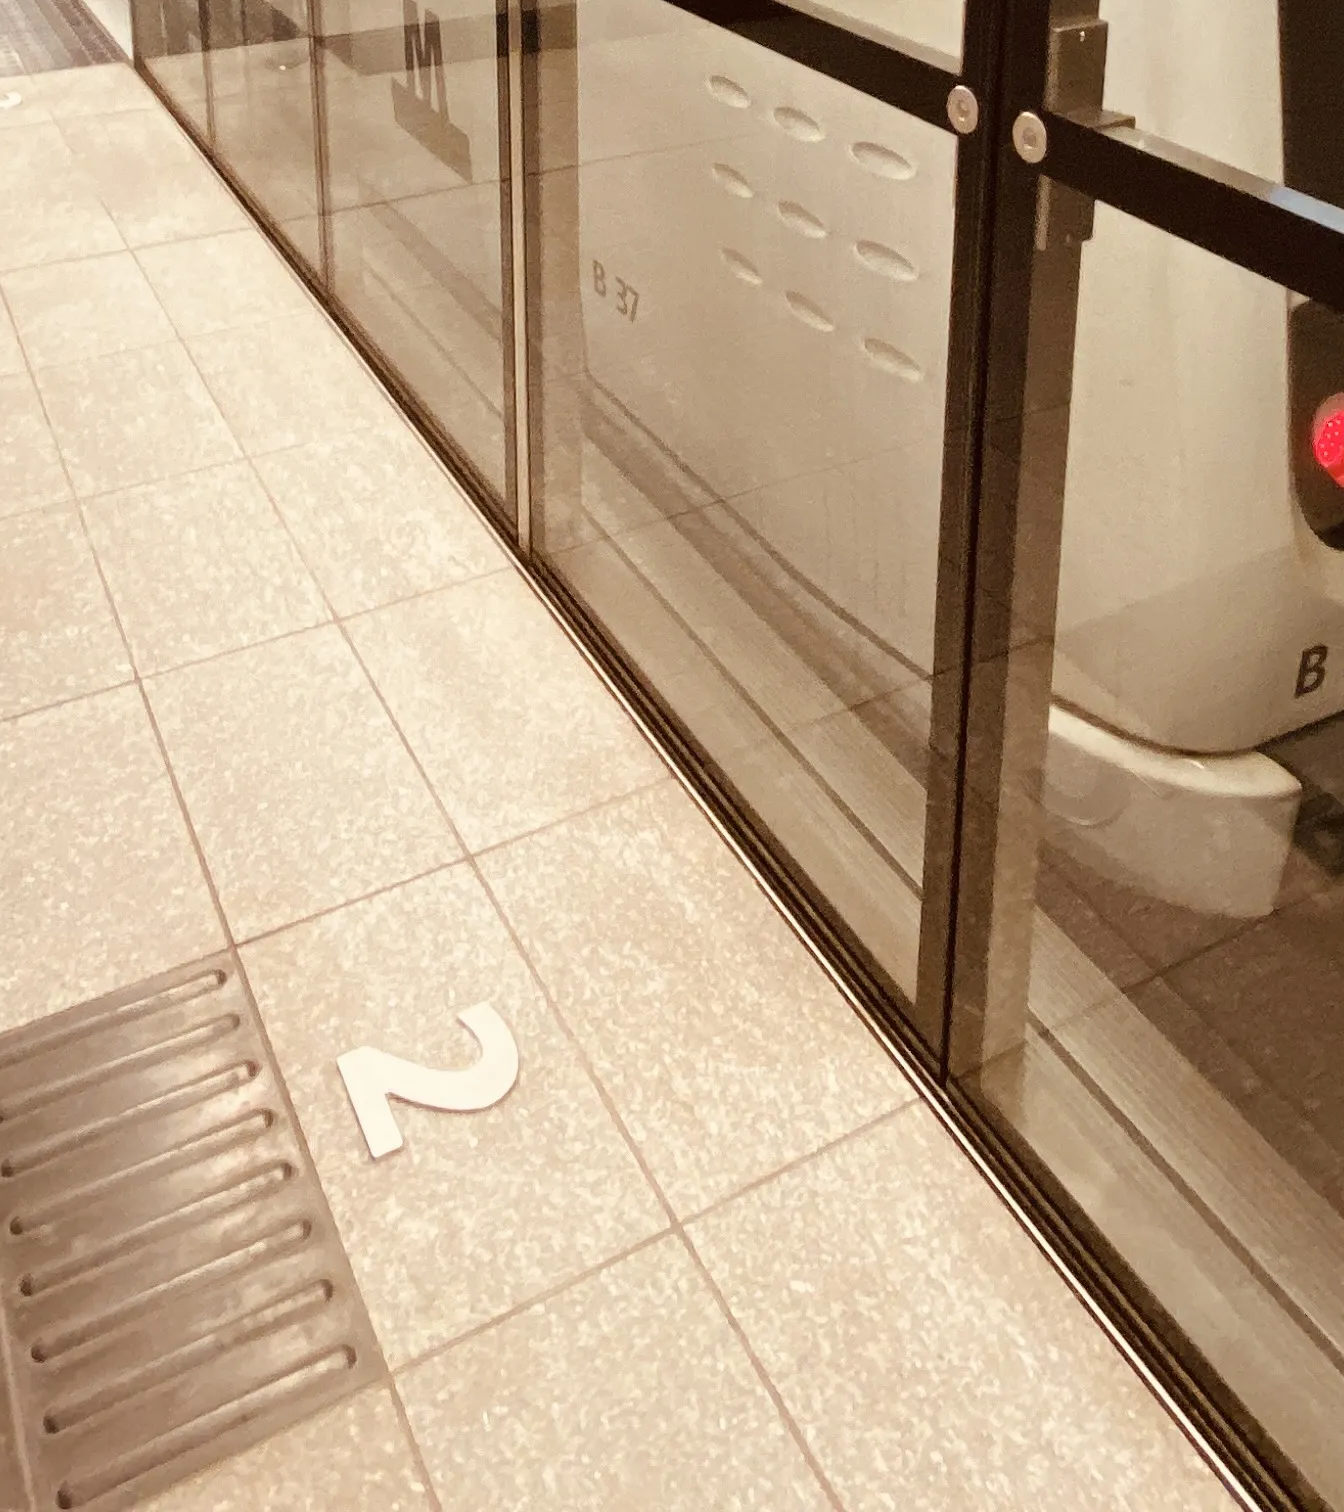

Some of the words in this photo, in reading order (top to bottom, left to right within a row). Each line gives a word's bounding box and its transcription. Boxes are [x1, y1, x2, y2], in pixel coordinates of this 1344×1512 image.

[592, 259, 607, 298] B
[615, 276, 640, 323] 37
[1294, 644, 1328, 699] B
[336, 1000, 519, 1160] 2
